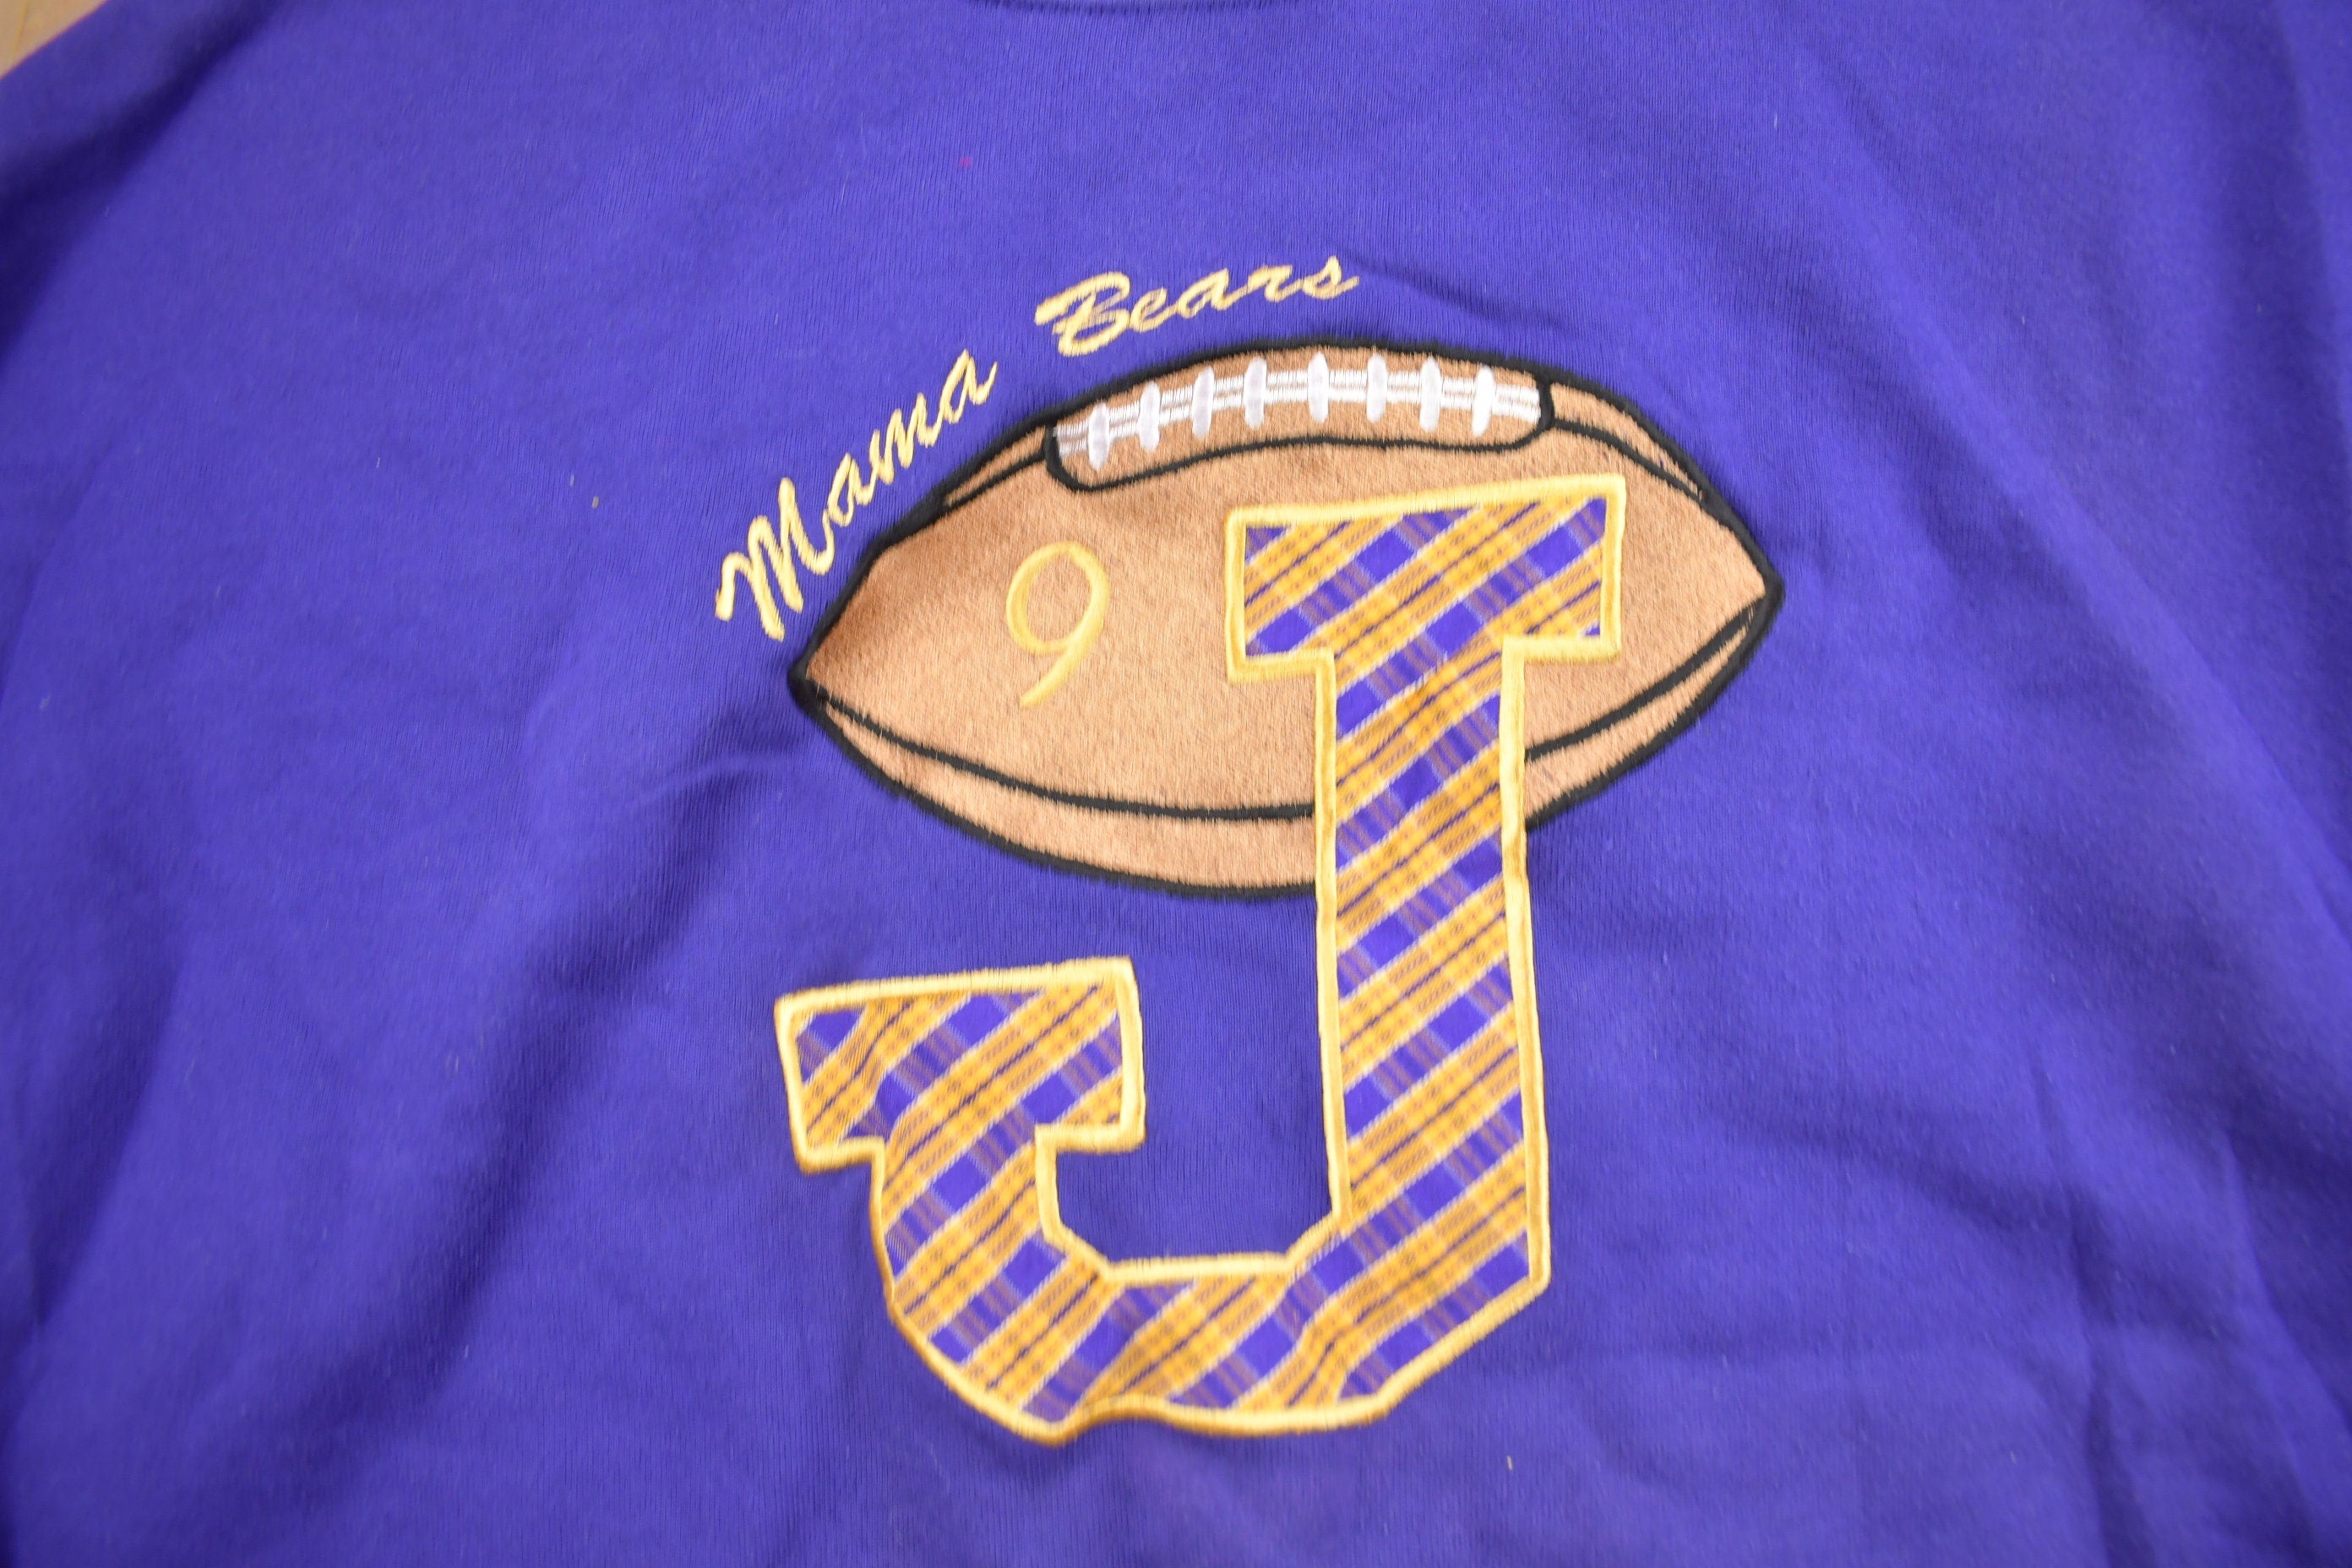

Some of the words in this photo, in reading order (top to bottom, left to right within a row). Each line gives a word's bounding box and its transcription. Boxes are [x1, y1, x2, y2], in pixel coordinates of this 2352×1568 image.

[715, 350, 998, 640] Mama
[1035, 256, 1358, 356] Bears
[1005, 541, 1111, 706] 9
[775, 473, 1626, 1445] J
